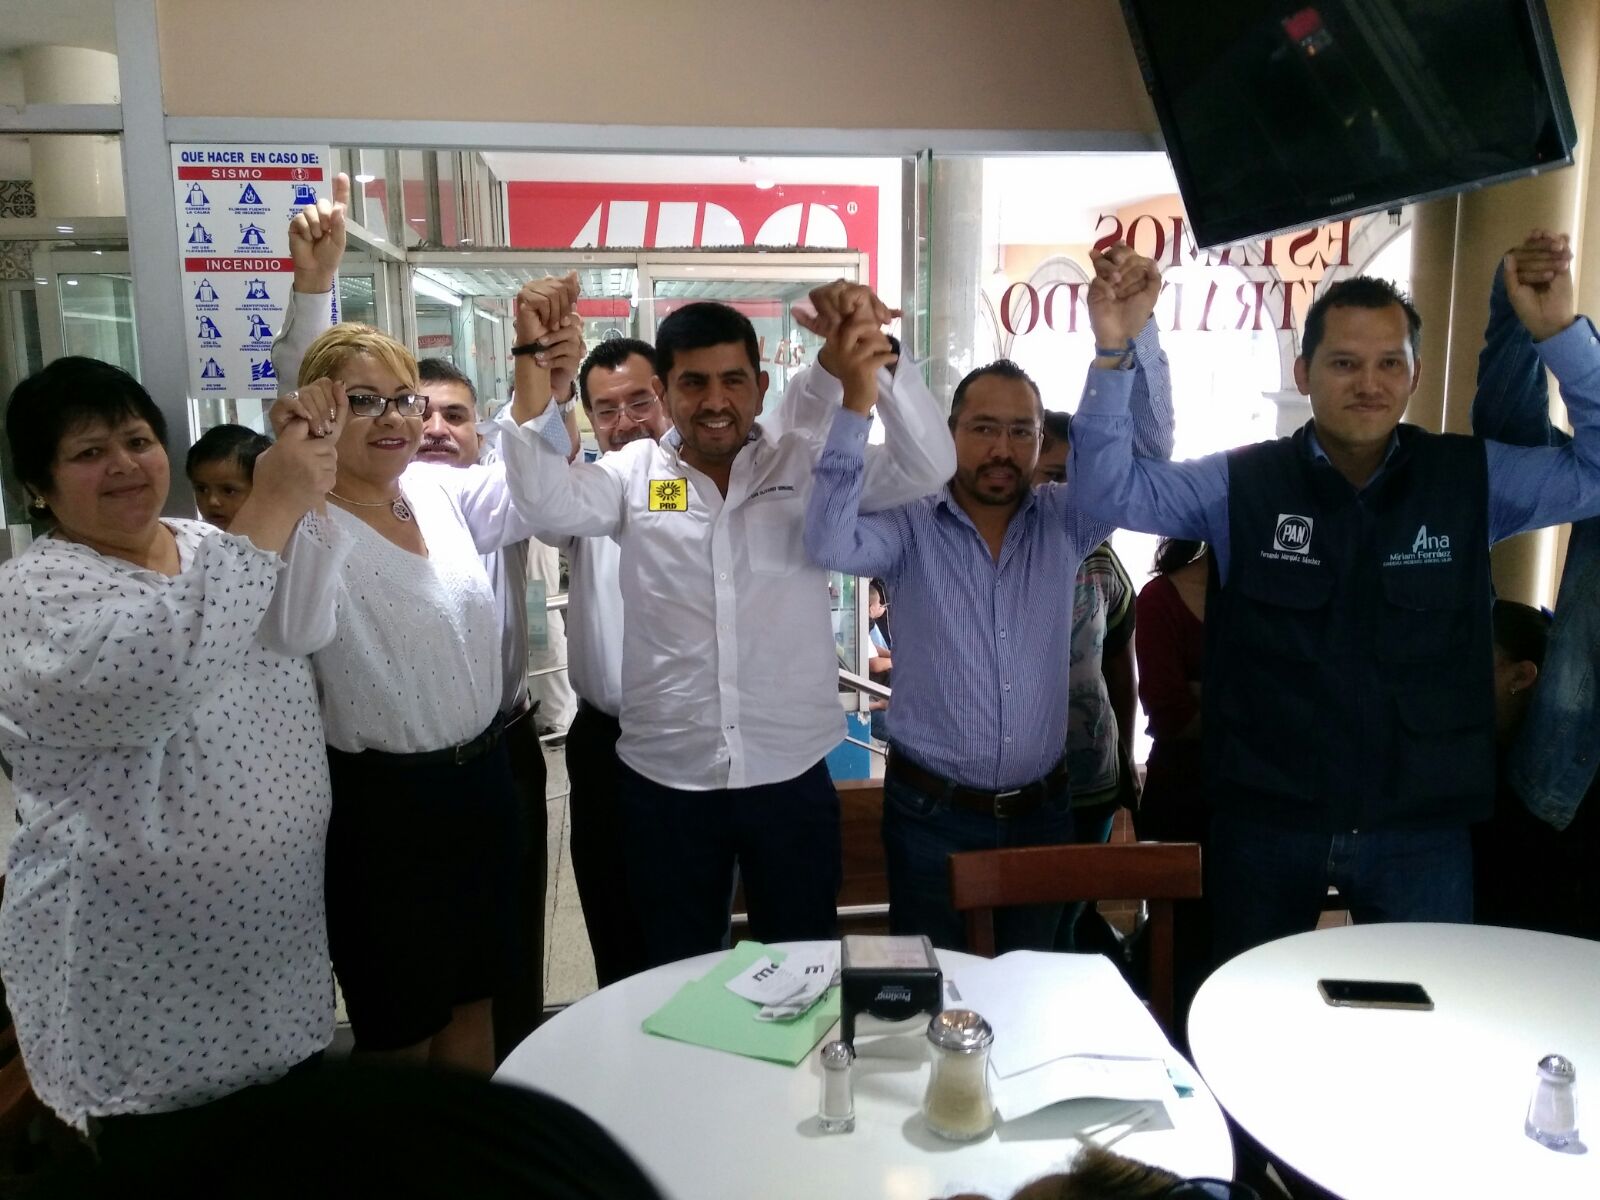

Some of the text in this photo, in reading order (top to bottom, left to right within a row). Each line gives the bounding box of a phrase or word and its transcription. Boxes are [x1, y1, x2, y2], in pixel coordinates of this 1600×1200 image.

[181, 151, 319, 164] QUE HACER EN CASO DE:
[211, 169, 262, 179] SISMO
[206, 259, 281, 271] INCENDIO
[659, 502, 677, 510] PRD
[1282, 524, 1306, 544] PAN
[1412, 524, 1450, 553] Ana
[1389, 552, 1416, 562] Miriam
